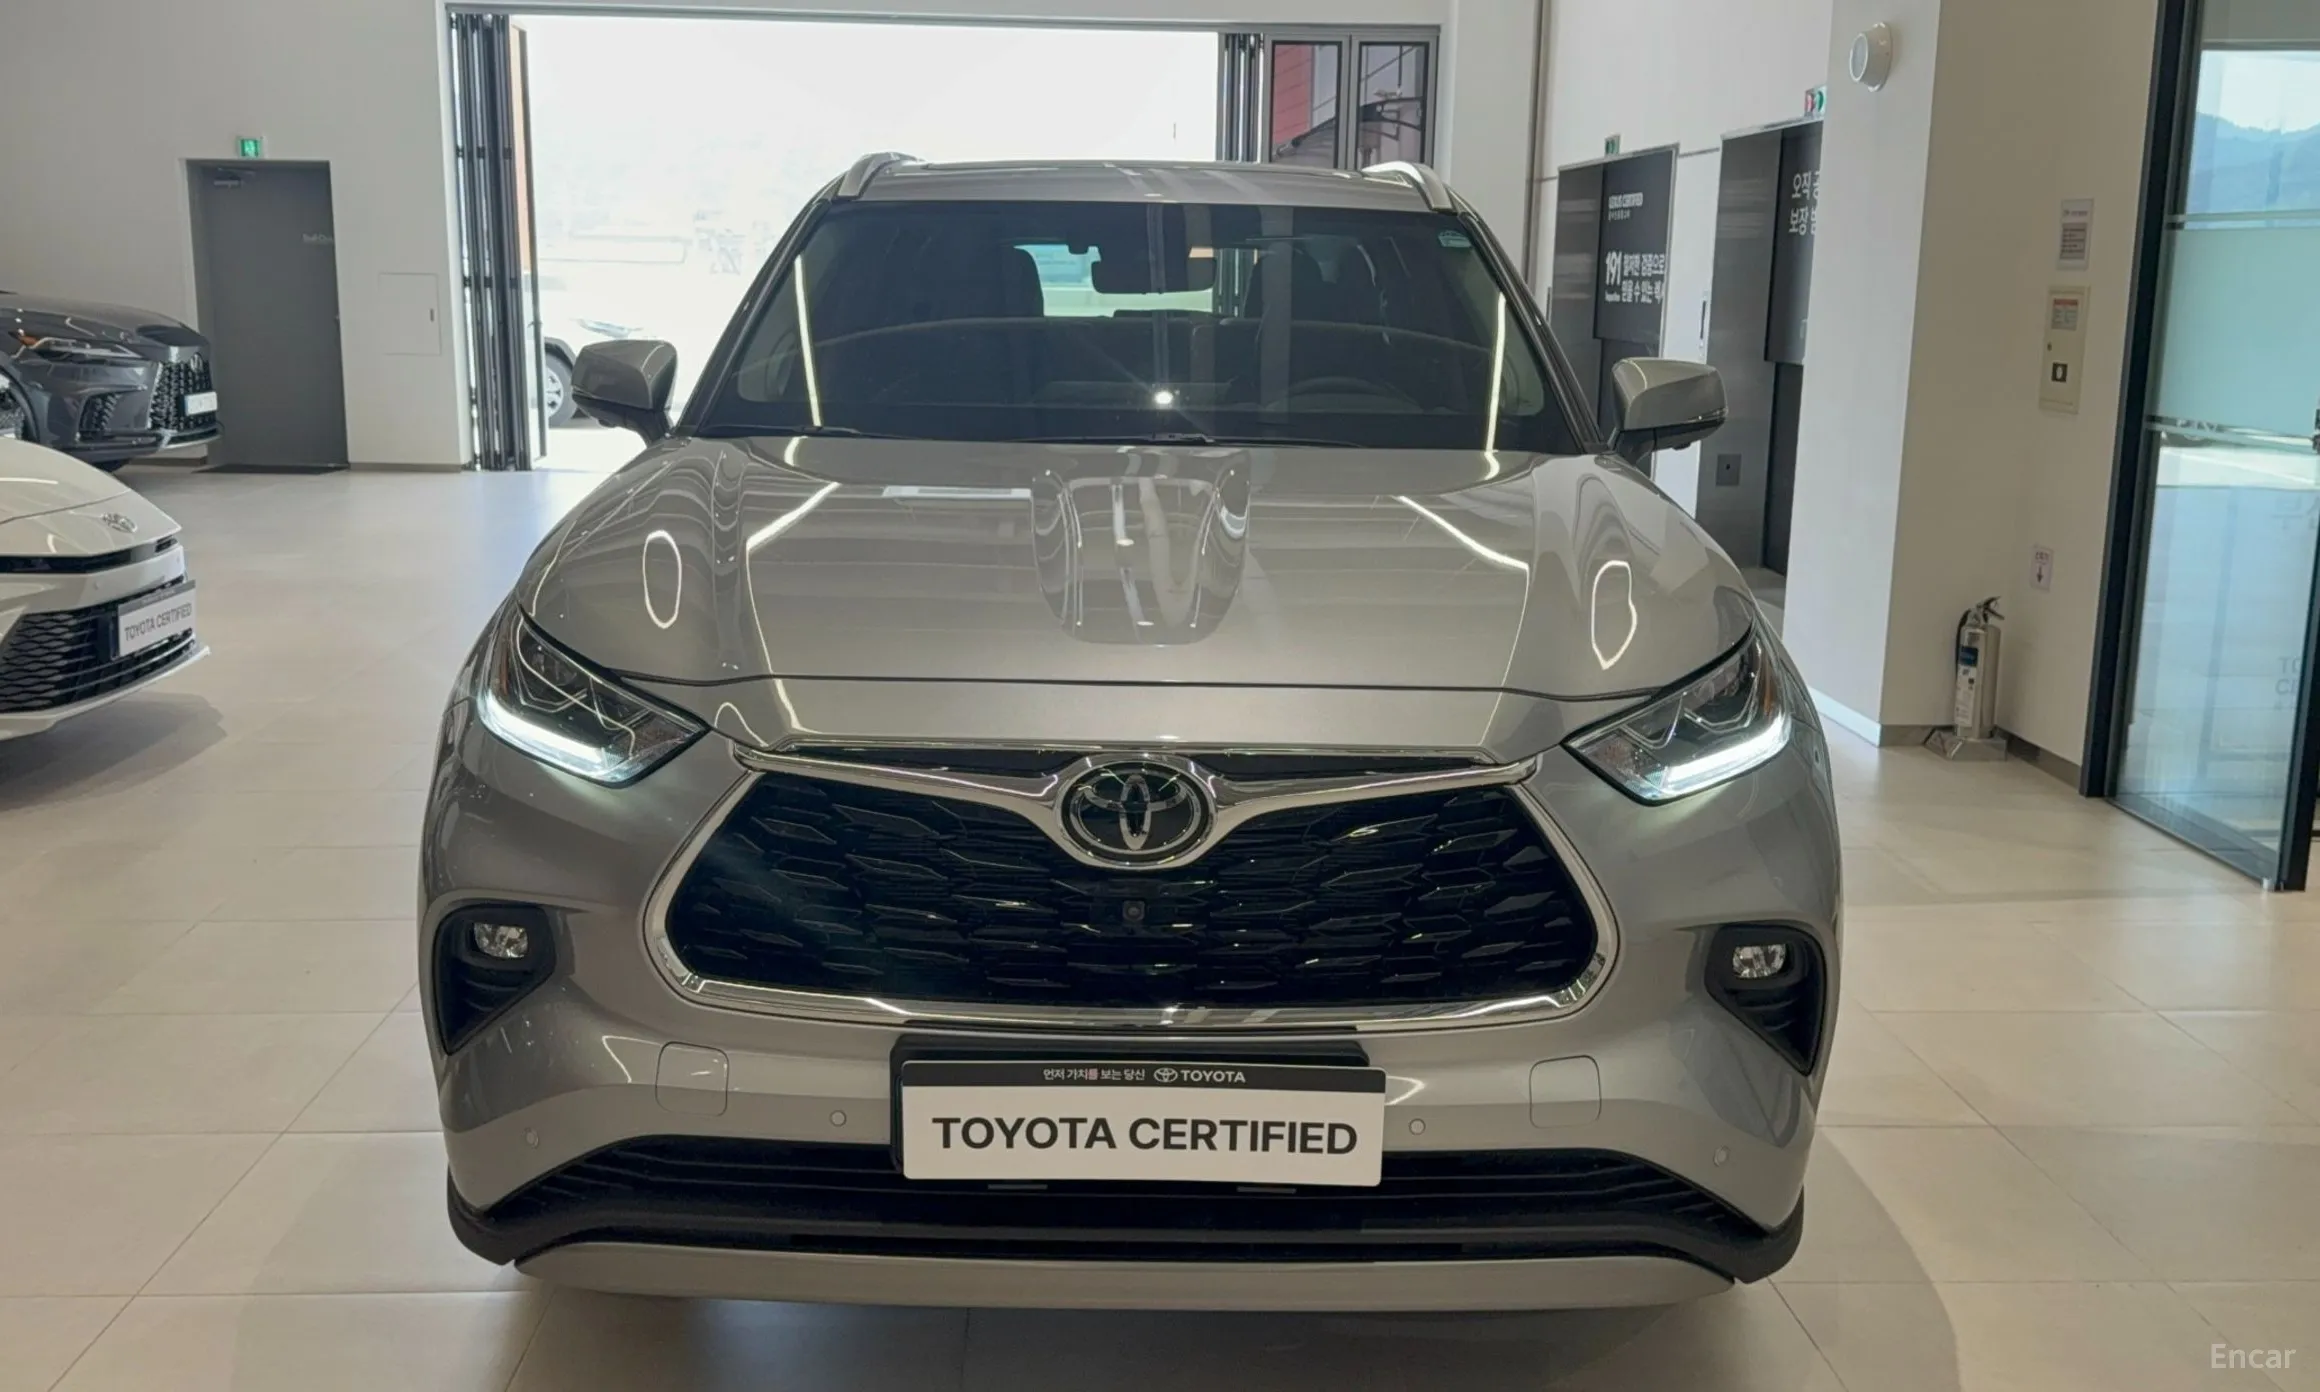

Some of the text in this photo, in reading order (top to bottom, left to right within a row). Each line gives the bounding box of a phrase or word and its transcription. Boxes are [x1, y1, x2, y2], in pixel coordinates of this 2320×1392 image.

[1791, 170, 1811, 200] 오직
[1788, 204, 1809, 236] 보장
[1605, 251, 1622, 286] 191
[124, 603, 193, 641] TOYOTA CERTIFIED
[1043, 1068, 1246, 1083] 먼저 가치를 보는 당신 TOYOTA
[932, 1116, 1358, 1154] TOYOTA CERTIFIED
